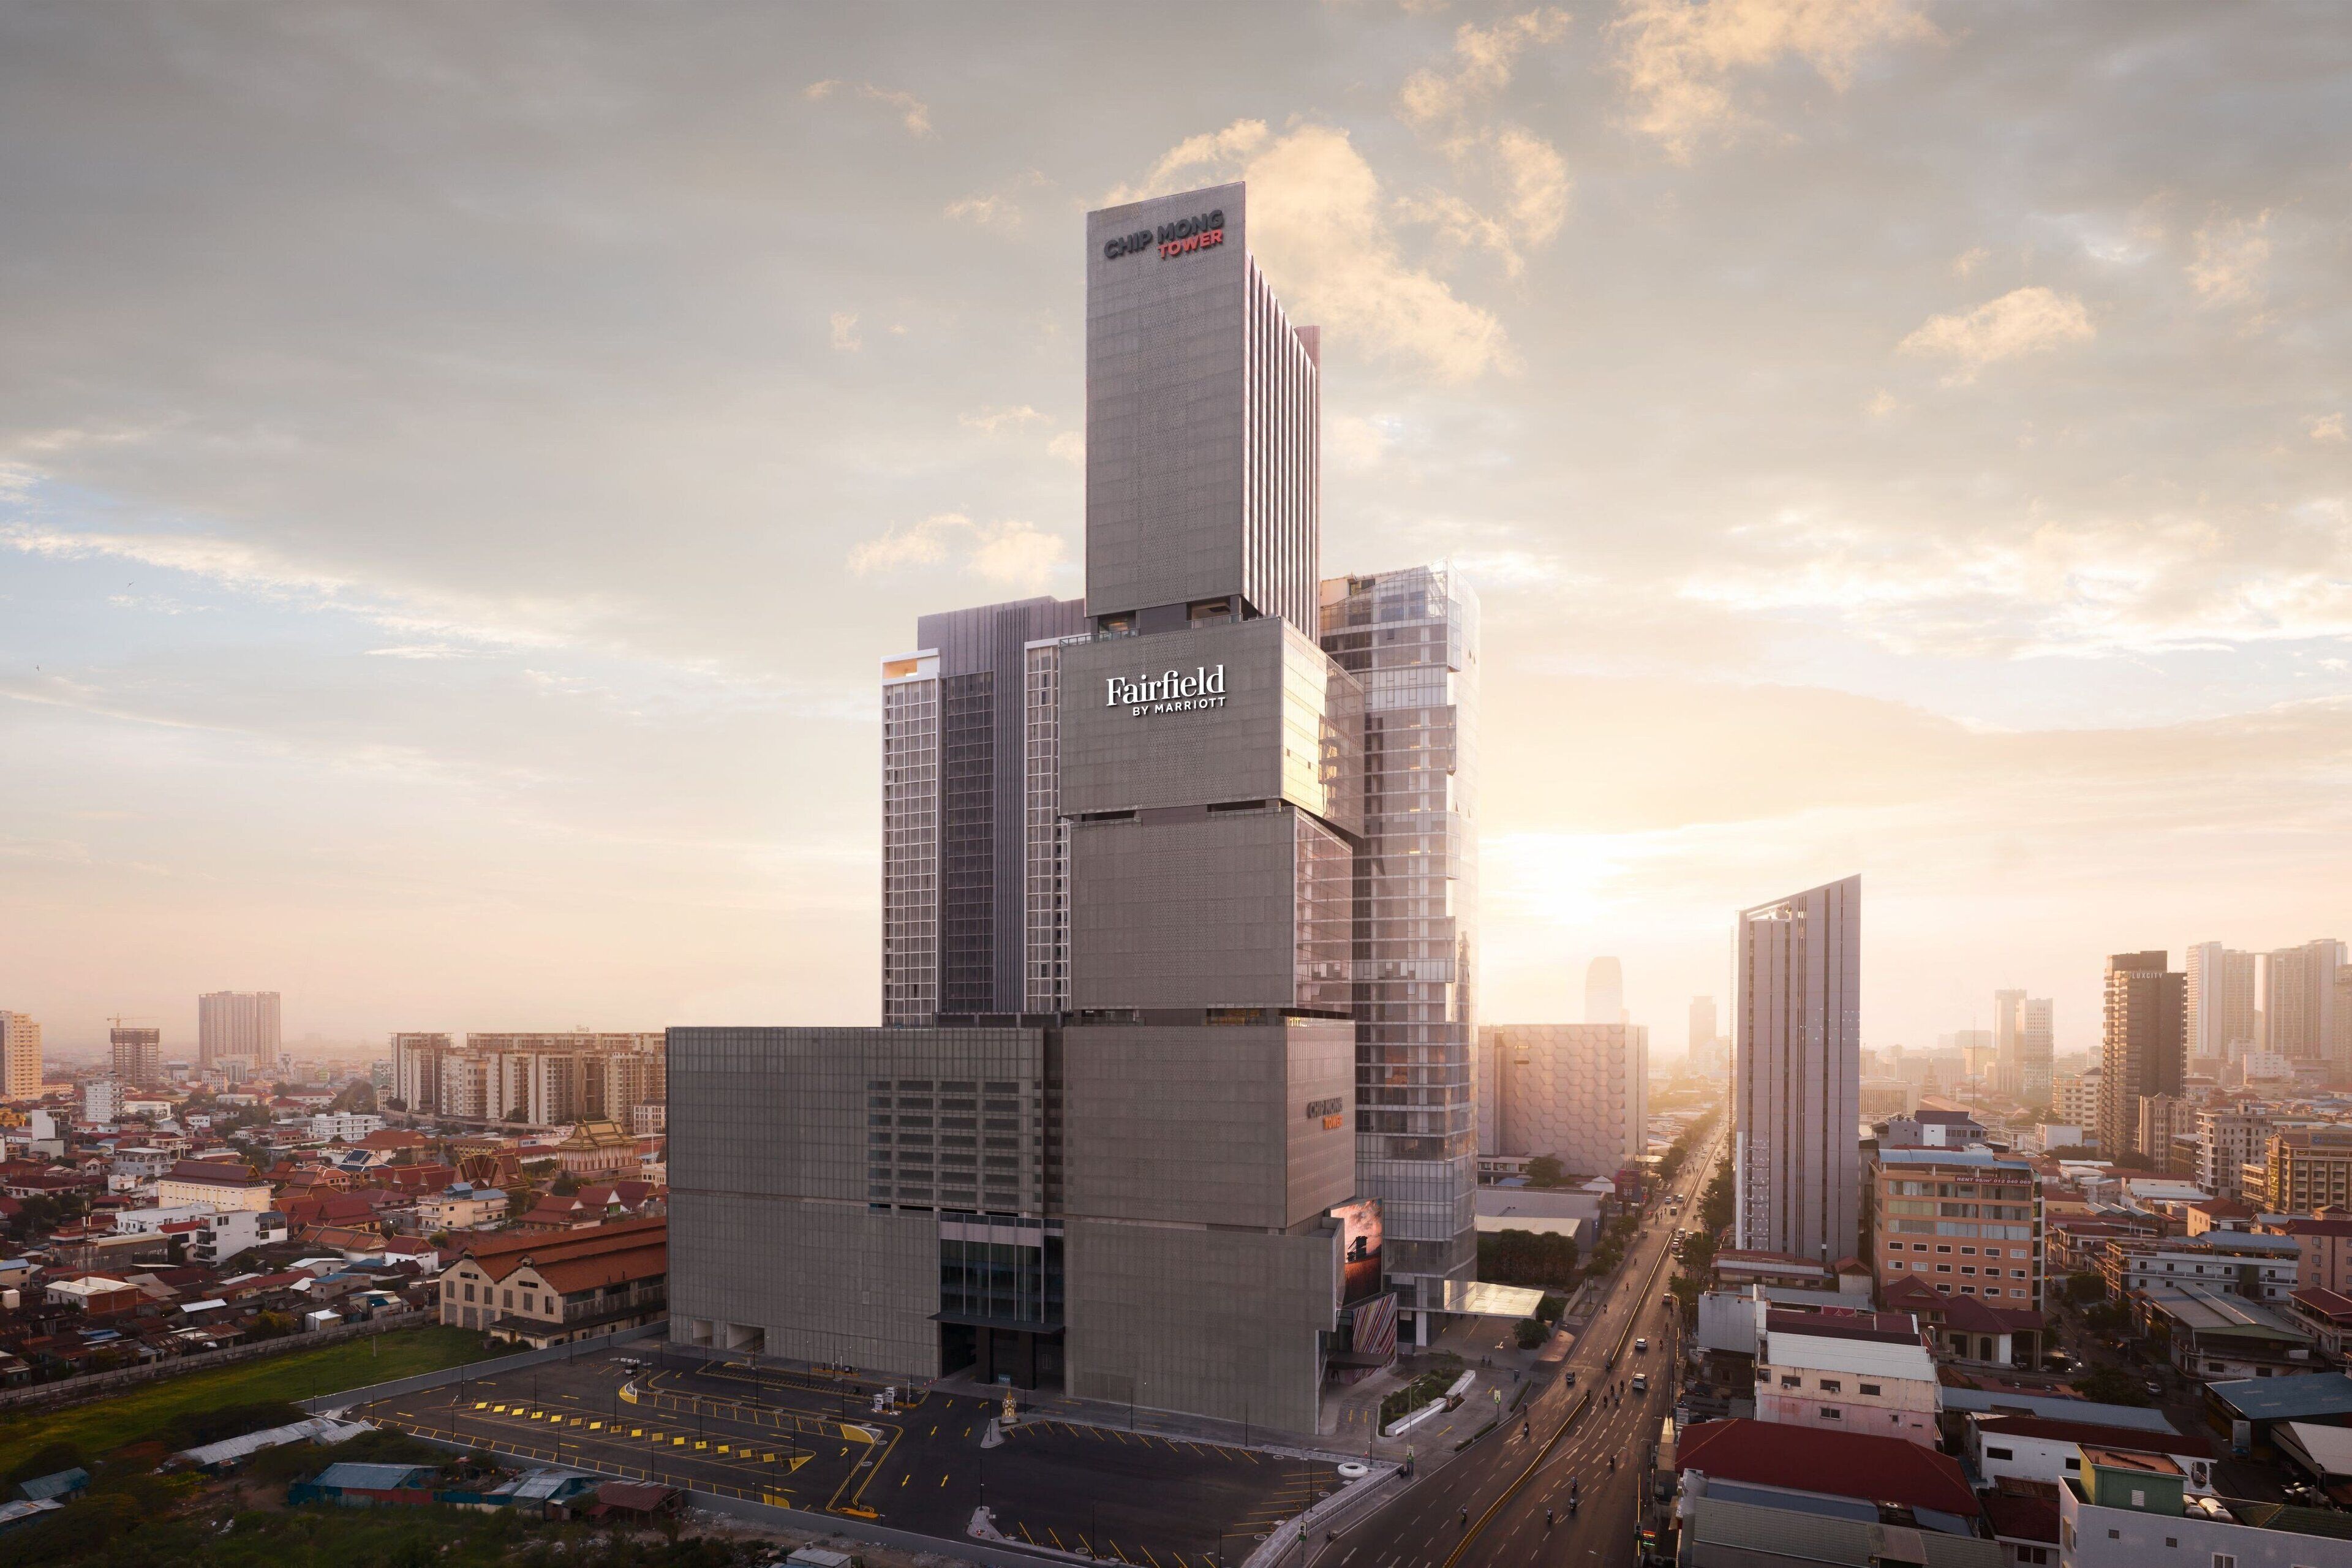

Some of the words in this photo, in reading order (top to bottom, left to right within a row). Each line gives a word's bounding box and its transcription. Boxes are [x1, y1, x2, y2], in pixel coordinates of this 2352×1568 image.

[1104, 229, 1153, 258] CHIP
[1157, 209, 1224, 244] MONG
[1156, 229, 1223, 259] TOWER
[1106, 665, 1226, 706] Fairfield
[1133, 706, 1149, 716] BY
[1155, 697, 1226, 714] MARRIOTT
[1322, 1115, 1343, 1130] TOWER
